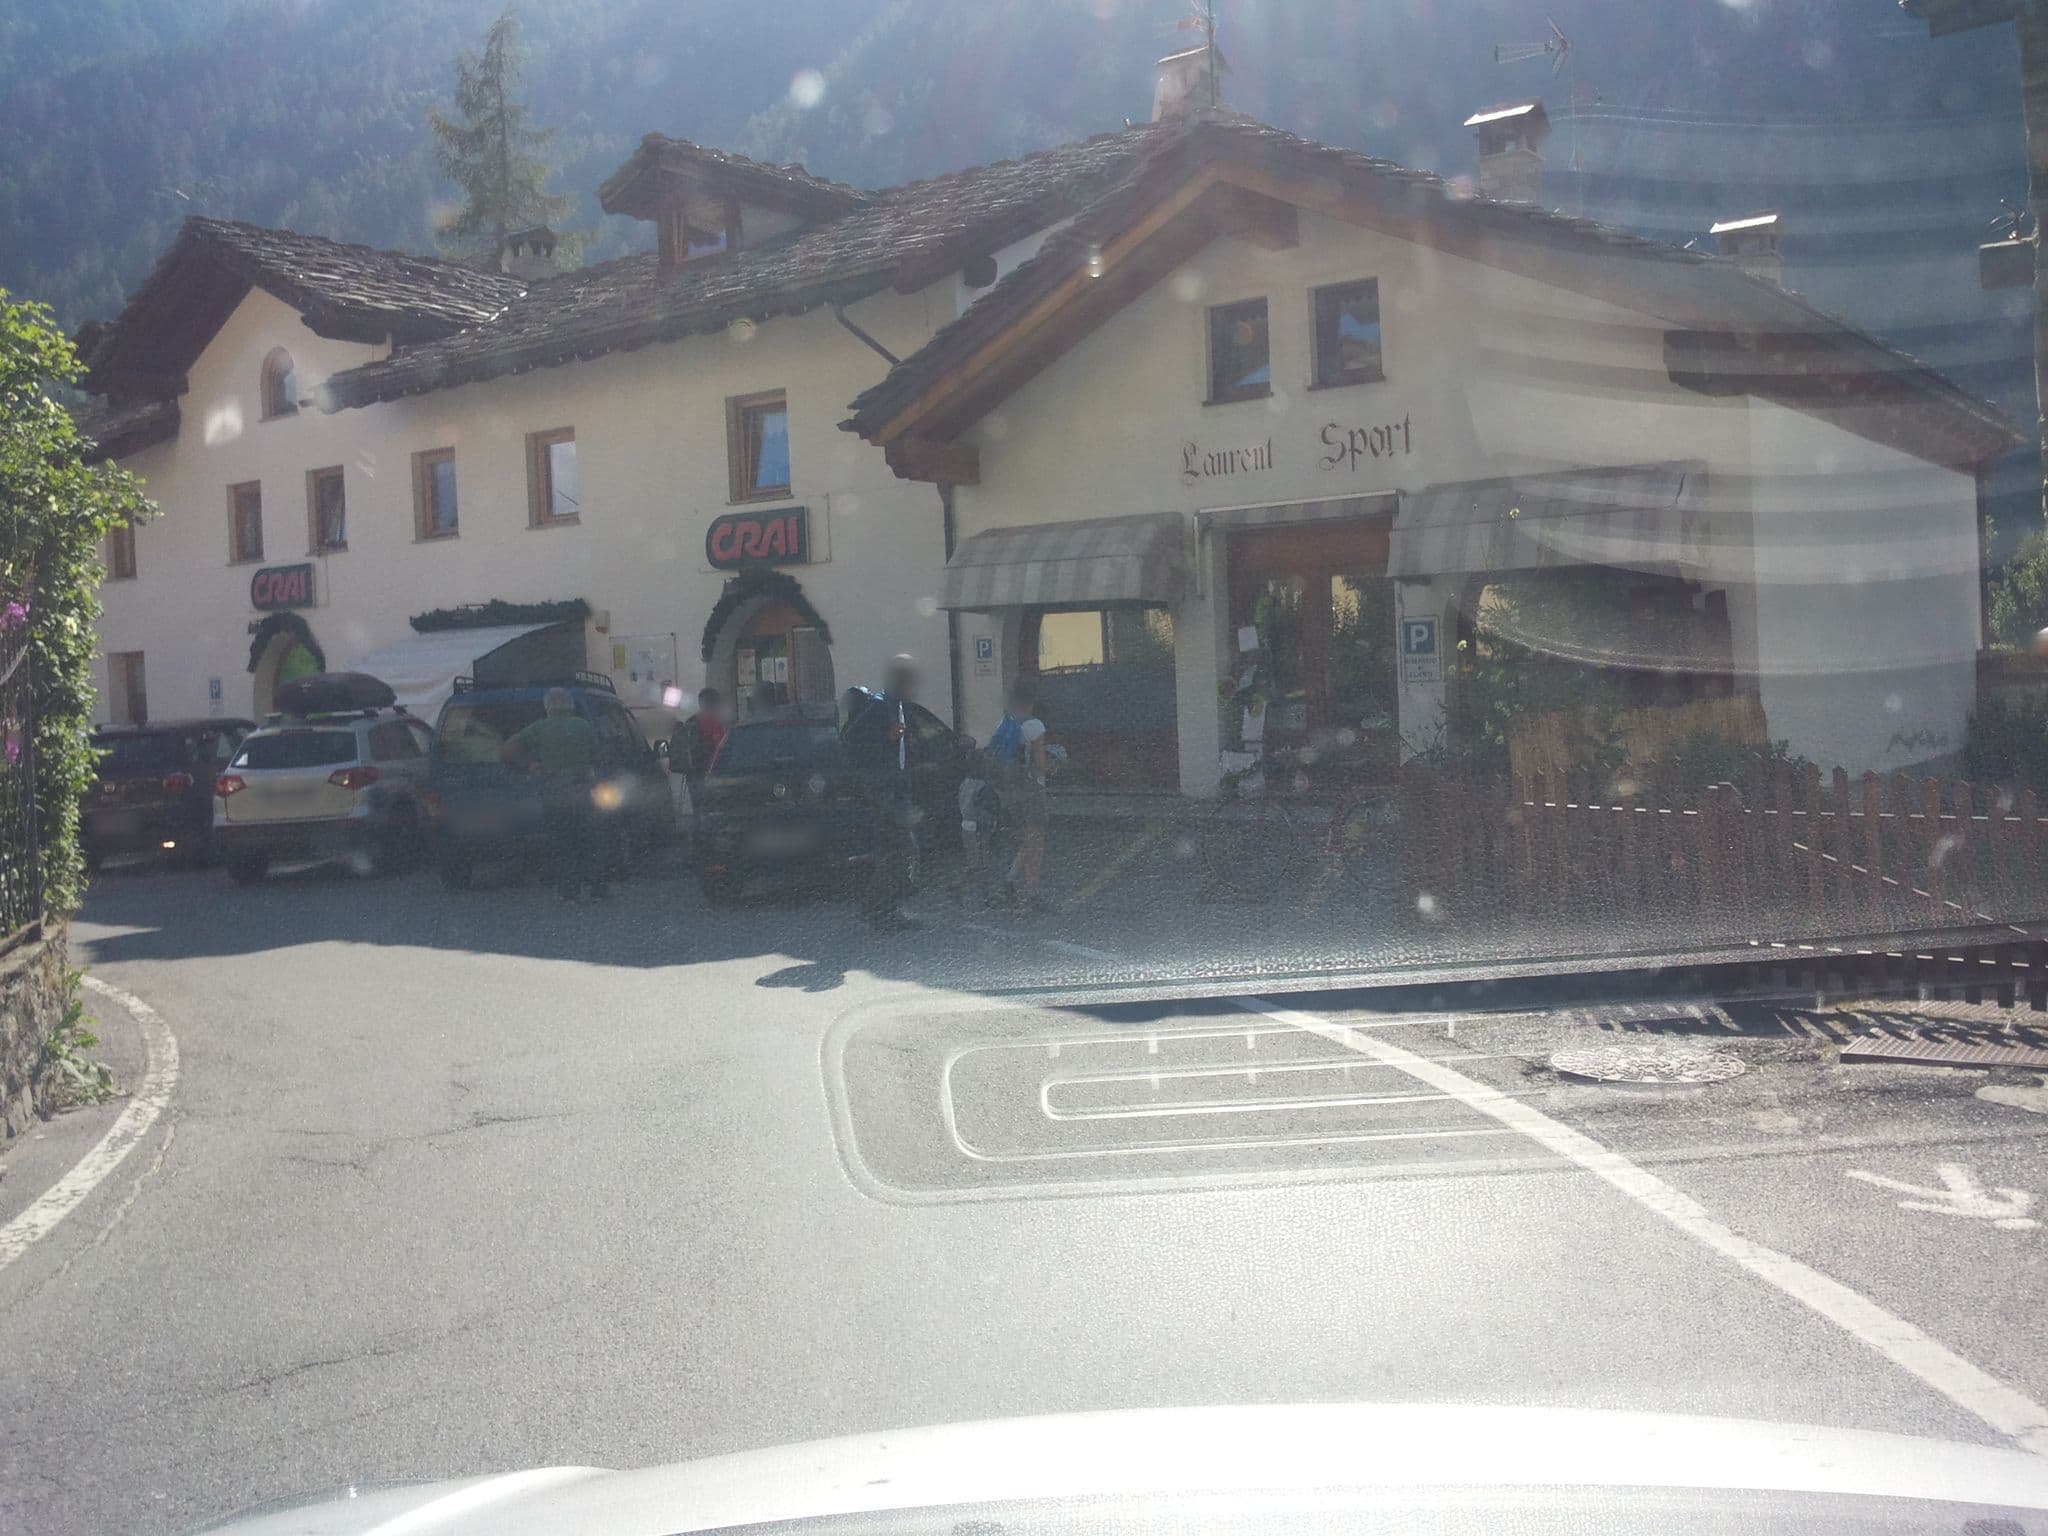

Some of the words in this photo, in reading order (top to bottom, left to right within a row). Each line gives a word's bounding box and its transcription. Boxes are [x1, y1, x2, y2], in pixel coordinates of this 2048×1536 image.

[1182, 437, 1273, 486] Laurent
[1319, 413, 1411, 472] Sport
[711, 516, 800, 561] CRAI
[255, 571, 306, 605] CRAI
[979, 640, 990, 657] P
[1410, 624, 1429, 652] P
